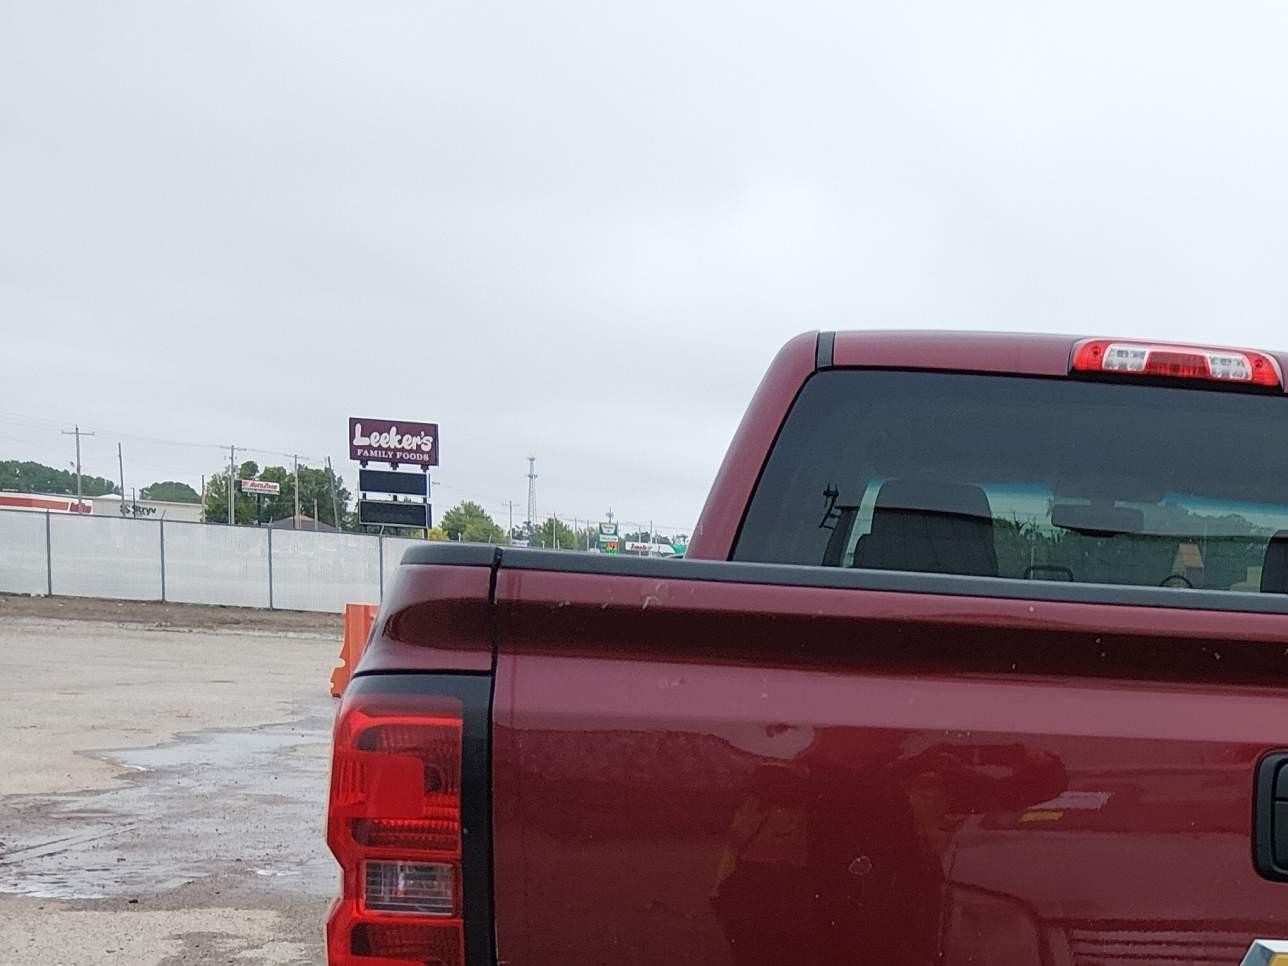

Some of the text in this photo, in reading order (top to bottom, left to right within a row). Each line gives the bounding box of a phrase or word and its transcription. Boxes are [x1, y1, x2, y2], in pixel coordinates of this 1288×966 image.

[353, 423, 433, 452] Leeker's
[357, 449, 429, 461] FAMILY FOODS
